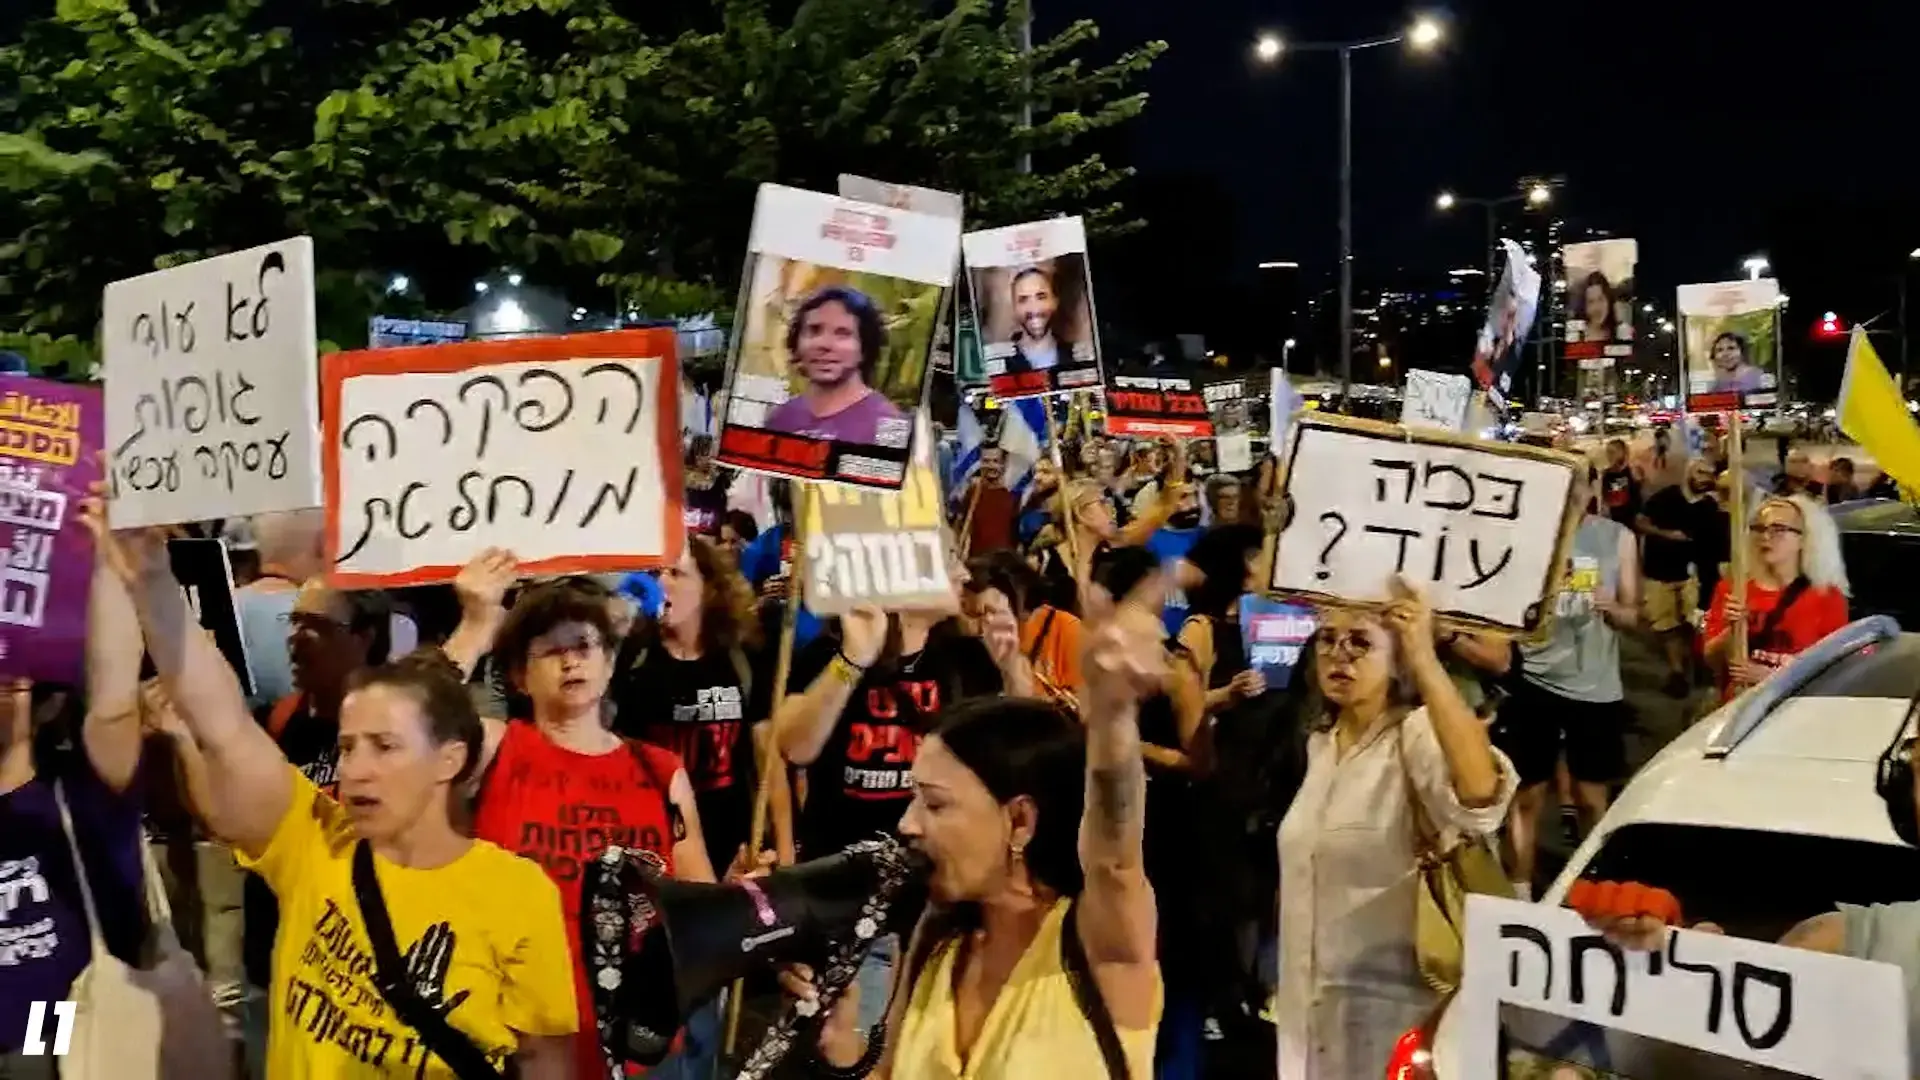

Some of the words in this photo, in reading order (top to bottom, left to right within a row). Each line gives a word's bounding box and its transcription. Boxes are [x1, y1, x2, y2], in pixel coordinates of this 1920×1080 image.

[133, 301, 196, 355] עוד
[226, 251, 285, 343] לא
[114, 370, 261, 460] גופות
[343, 362, 644, 461] הפקרה
[111, 451, 181, 499] עכשיו
[195, 429, 290, 493] עסקה
[334, 467, 638, 563] מוחלטת
[1500, 923, 1792, 1050] סליחה
